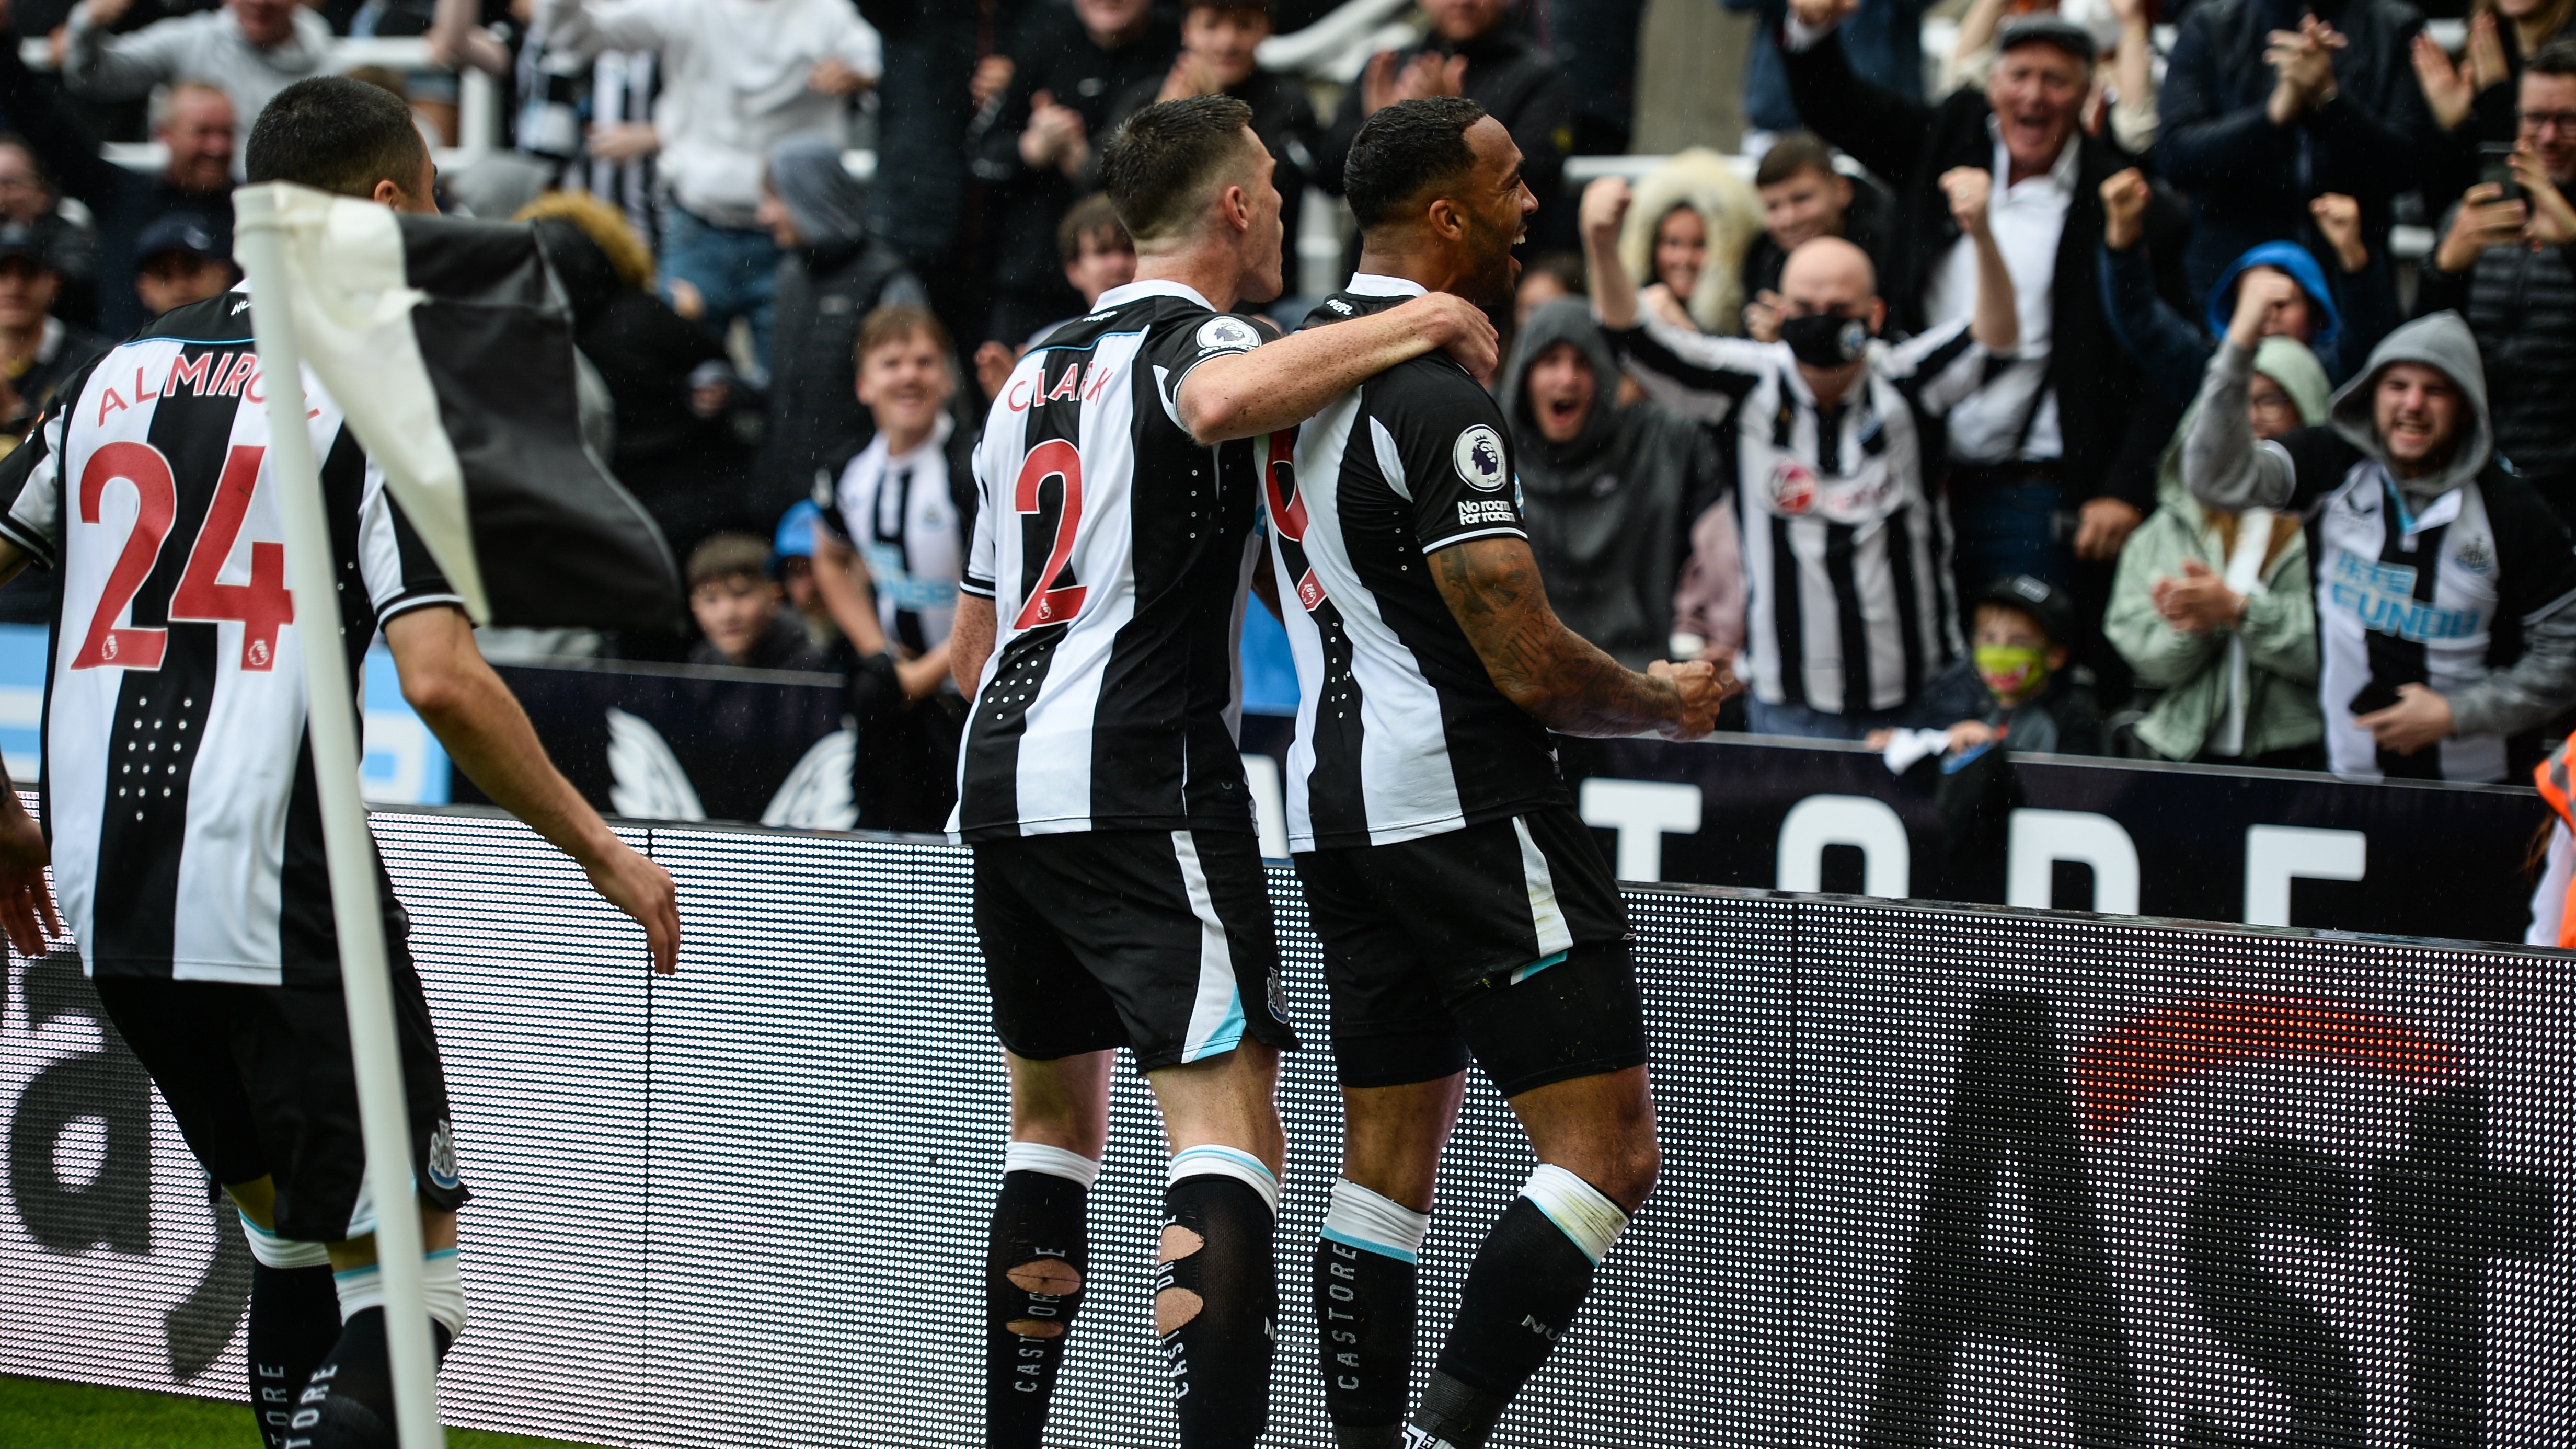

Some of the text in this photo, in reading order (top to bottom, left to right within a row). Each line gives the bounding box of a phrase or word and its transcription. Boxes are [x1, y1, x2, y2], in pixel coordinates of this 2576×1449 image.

[70, 441, 295, 672] 24
[1013, 438, 1088, 630] 2
[1457, 500, 1480, 514] No
[1328, 1243, 1359, 1390] CASTORE
[1521, 1314, 1566, 1342] NU
